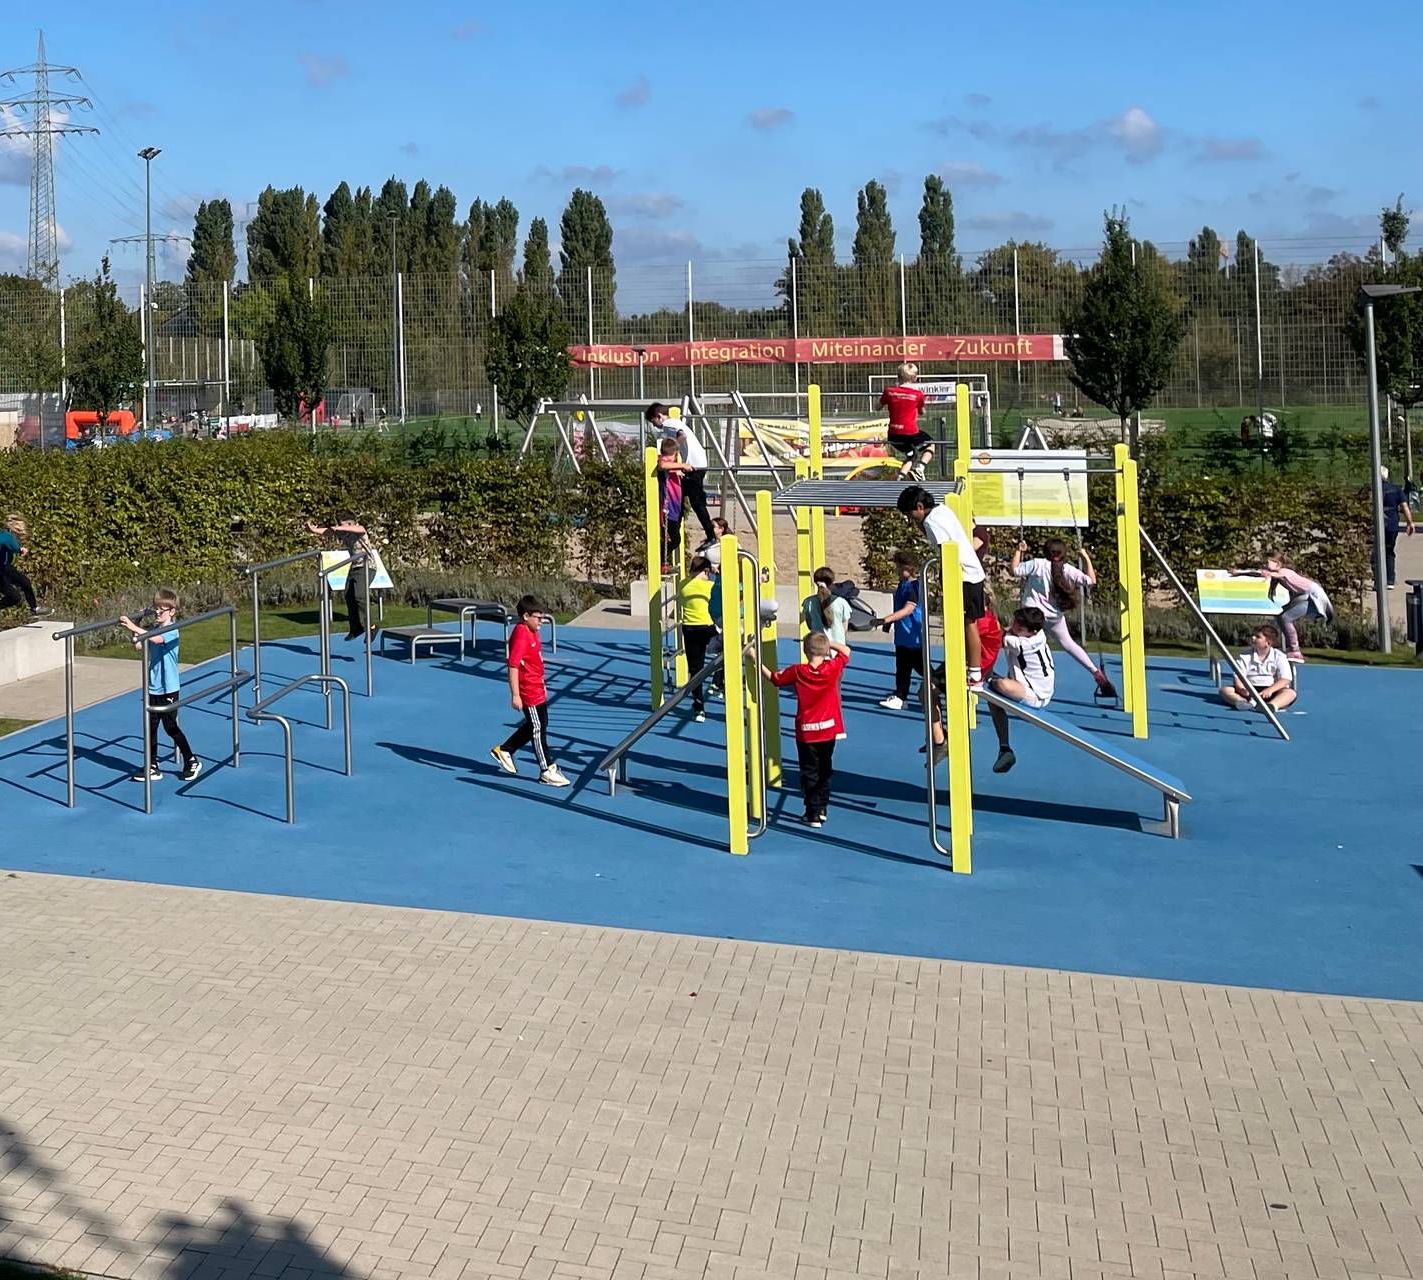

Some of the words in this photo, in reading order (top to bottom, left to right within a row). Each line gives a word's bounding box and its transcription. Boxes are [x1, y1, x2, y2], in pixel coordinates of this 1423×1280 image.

[582, 348, 660, 364] Inklusion
[685, 343, 785, 362] Integration
[812, 340, 927, 357] Miteinander
[953, 338, 1033, 355] Zukunft
